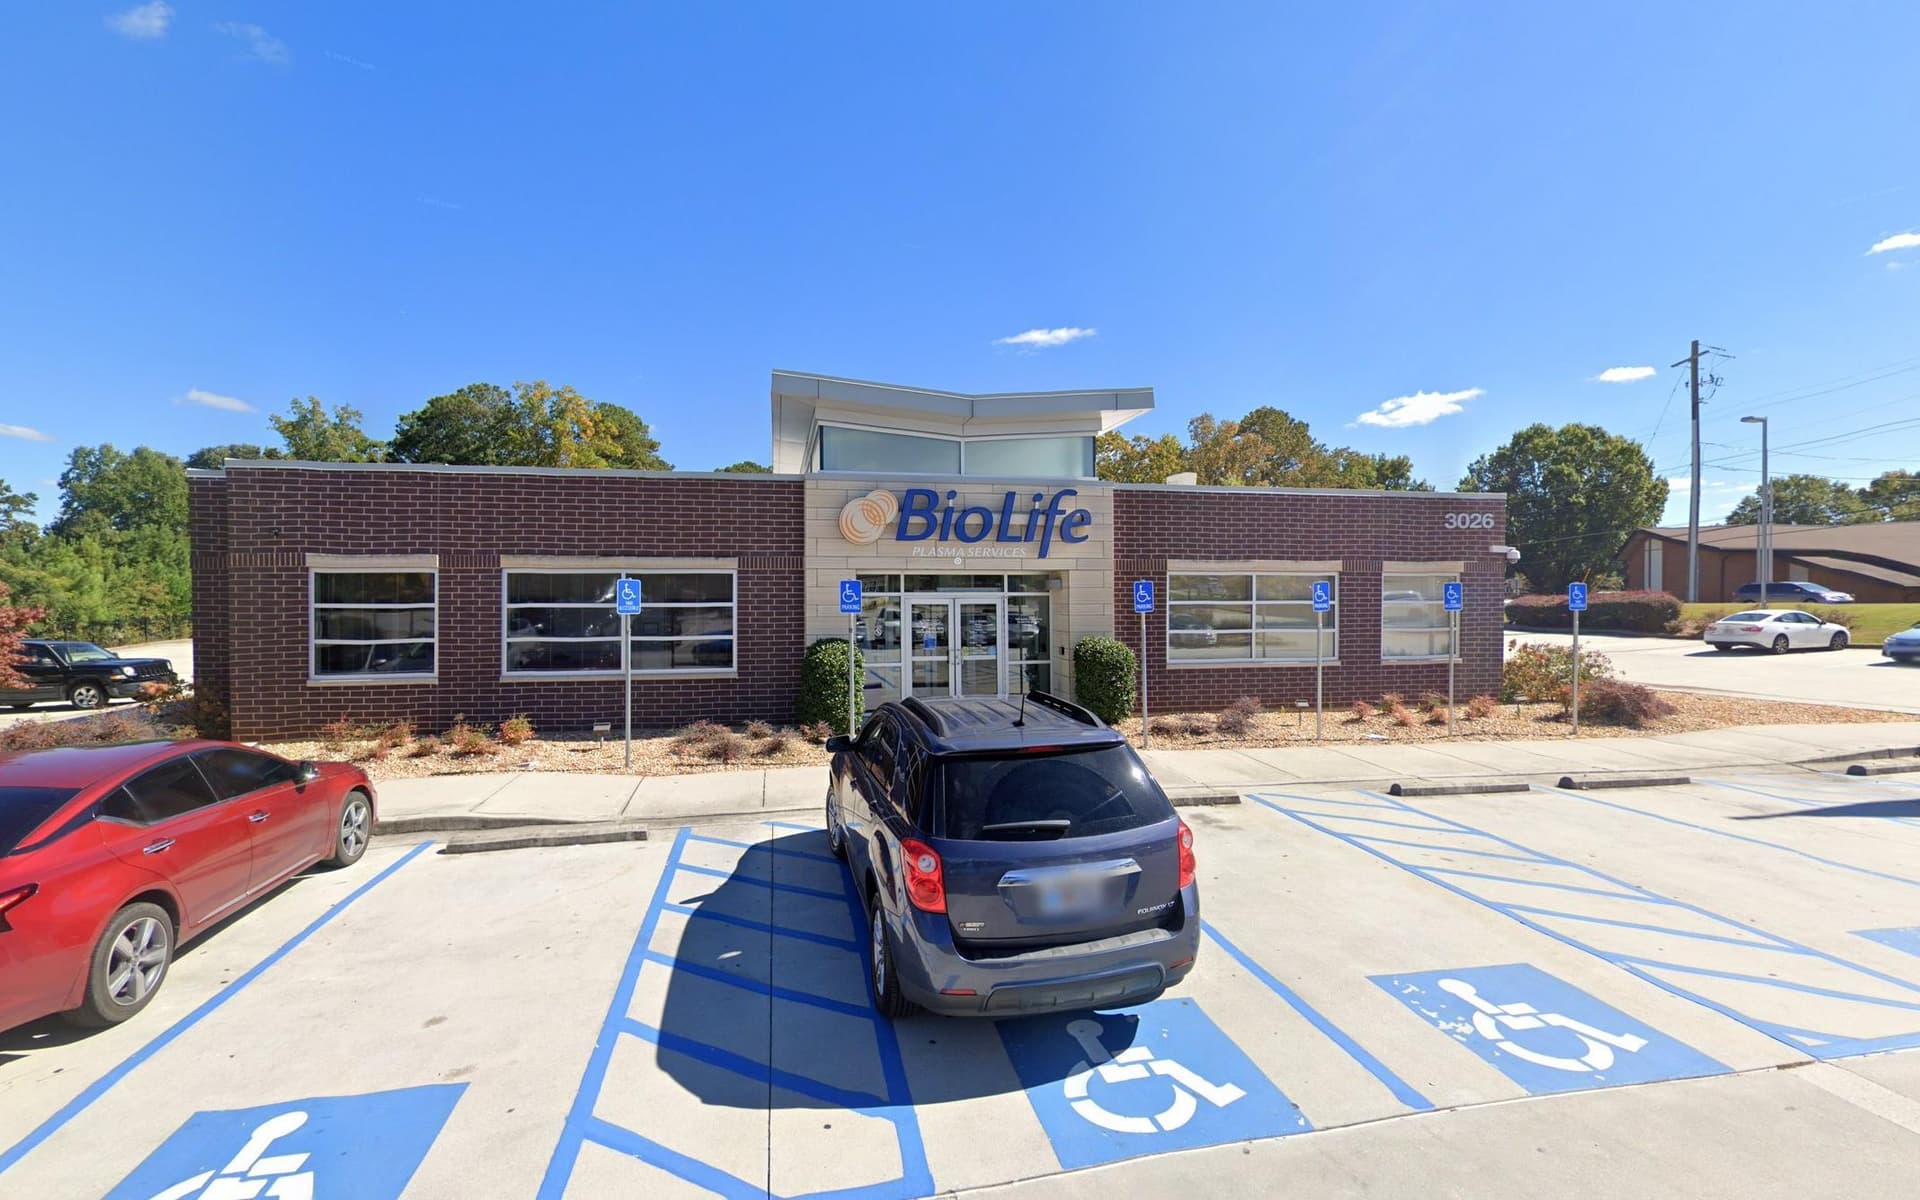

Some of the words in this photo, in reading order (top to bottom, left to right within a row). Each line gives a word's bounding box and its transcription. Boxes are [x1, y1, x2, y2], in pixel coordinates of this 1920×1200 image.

[896, 488, 1092, 559] BioLife
[1444, 512, 1495, 529] 3026
[912, 546, 965, 558] PLASMA
[967, 546, 1026, 558] SERVICES
